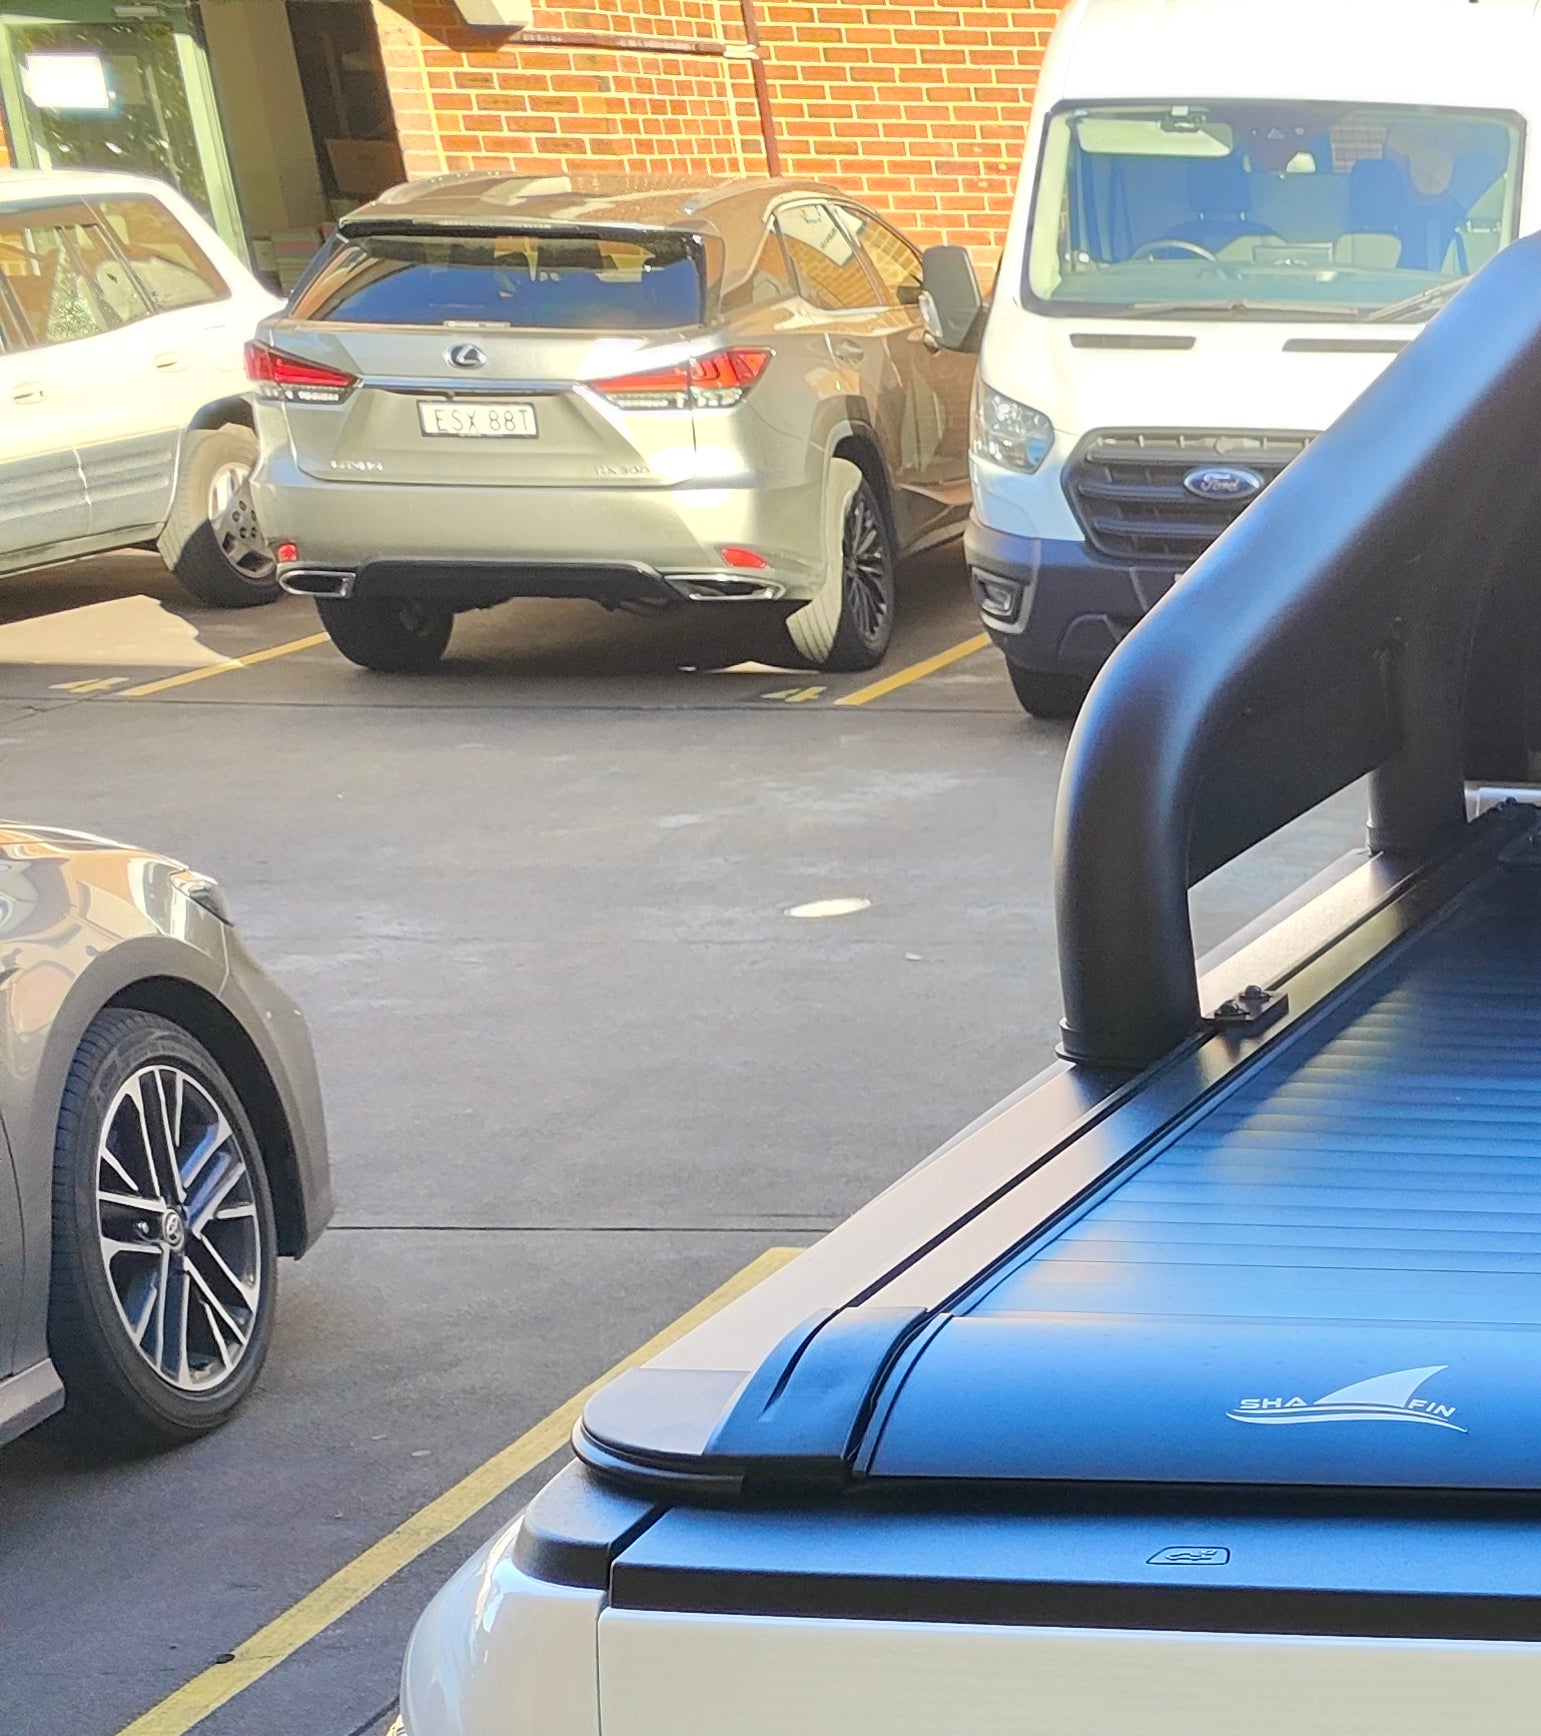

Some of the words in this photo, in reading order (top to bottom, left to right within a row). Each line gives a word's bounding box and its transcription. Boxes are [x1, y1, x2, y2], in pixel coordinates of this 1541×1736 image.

[434, 409, 480, 432] ESX
[488, 409, 529, 432] 88T
[1239, 1396, 1308, 1410] SHA
[1407, 1398, 1457, 1418] FIN
